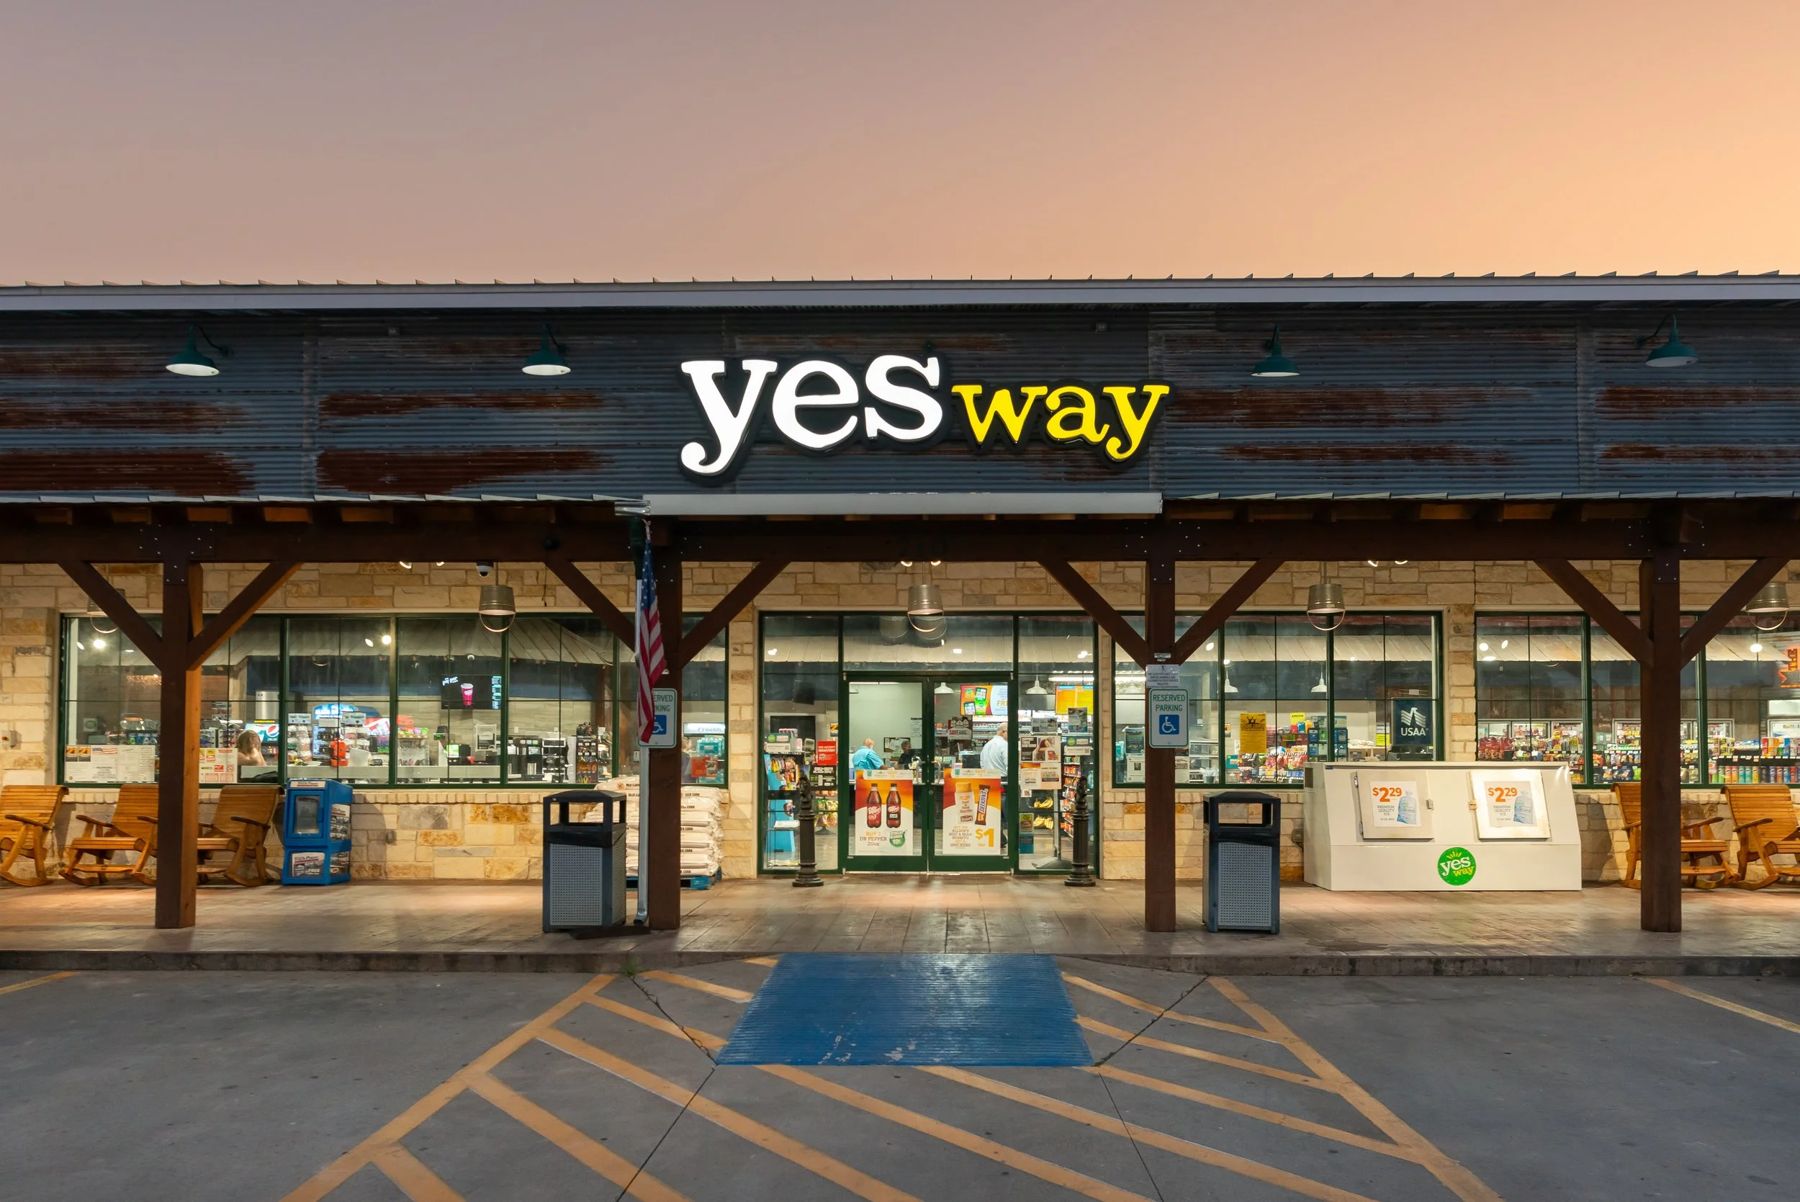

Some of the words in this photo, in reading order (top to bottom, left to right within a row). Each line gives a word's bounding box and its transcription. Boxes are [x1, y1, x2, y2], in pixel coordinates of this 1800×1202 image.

[680, 354, 943, 476] yes
[951, 384, 1170, 461] way
[1153, 694, 1185, 702] RESERVED
[1400, 727, 1426, 736] USAA
[975, 828, 994, 848] $1
[1440, 856, 1471, 876] yes
[1453, 866, 1474, 876] way
